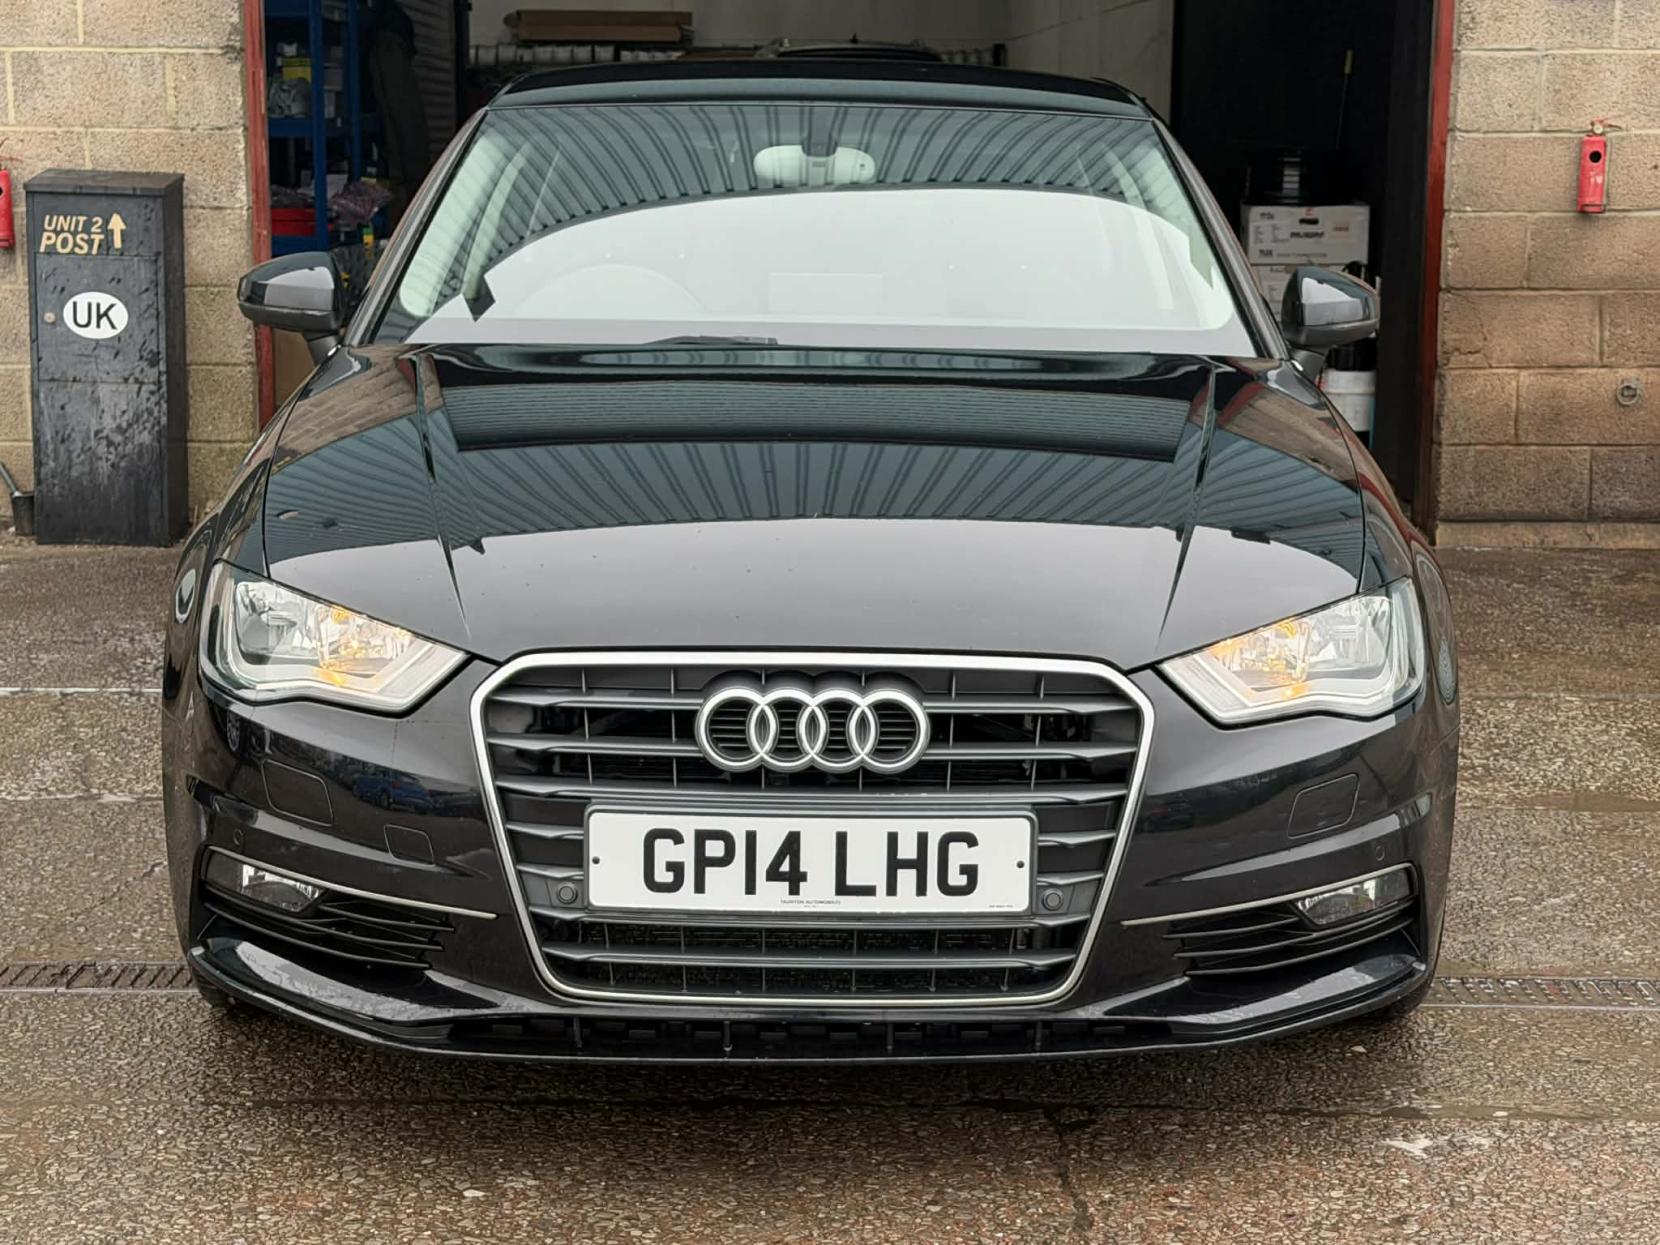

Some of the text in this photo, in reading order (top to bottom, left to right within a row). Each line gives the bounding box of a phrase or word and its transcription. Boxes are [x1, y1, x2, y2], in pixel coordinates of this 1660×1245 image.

[43, 214, 104, 233] UNIT 2
[39, 232, 105, 255] POST
[72, 301, 118, 330] UK
[643, 826, 980, 898] GP14 LHG
